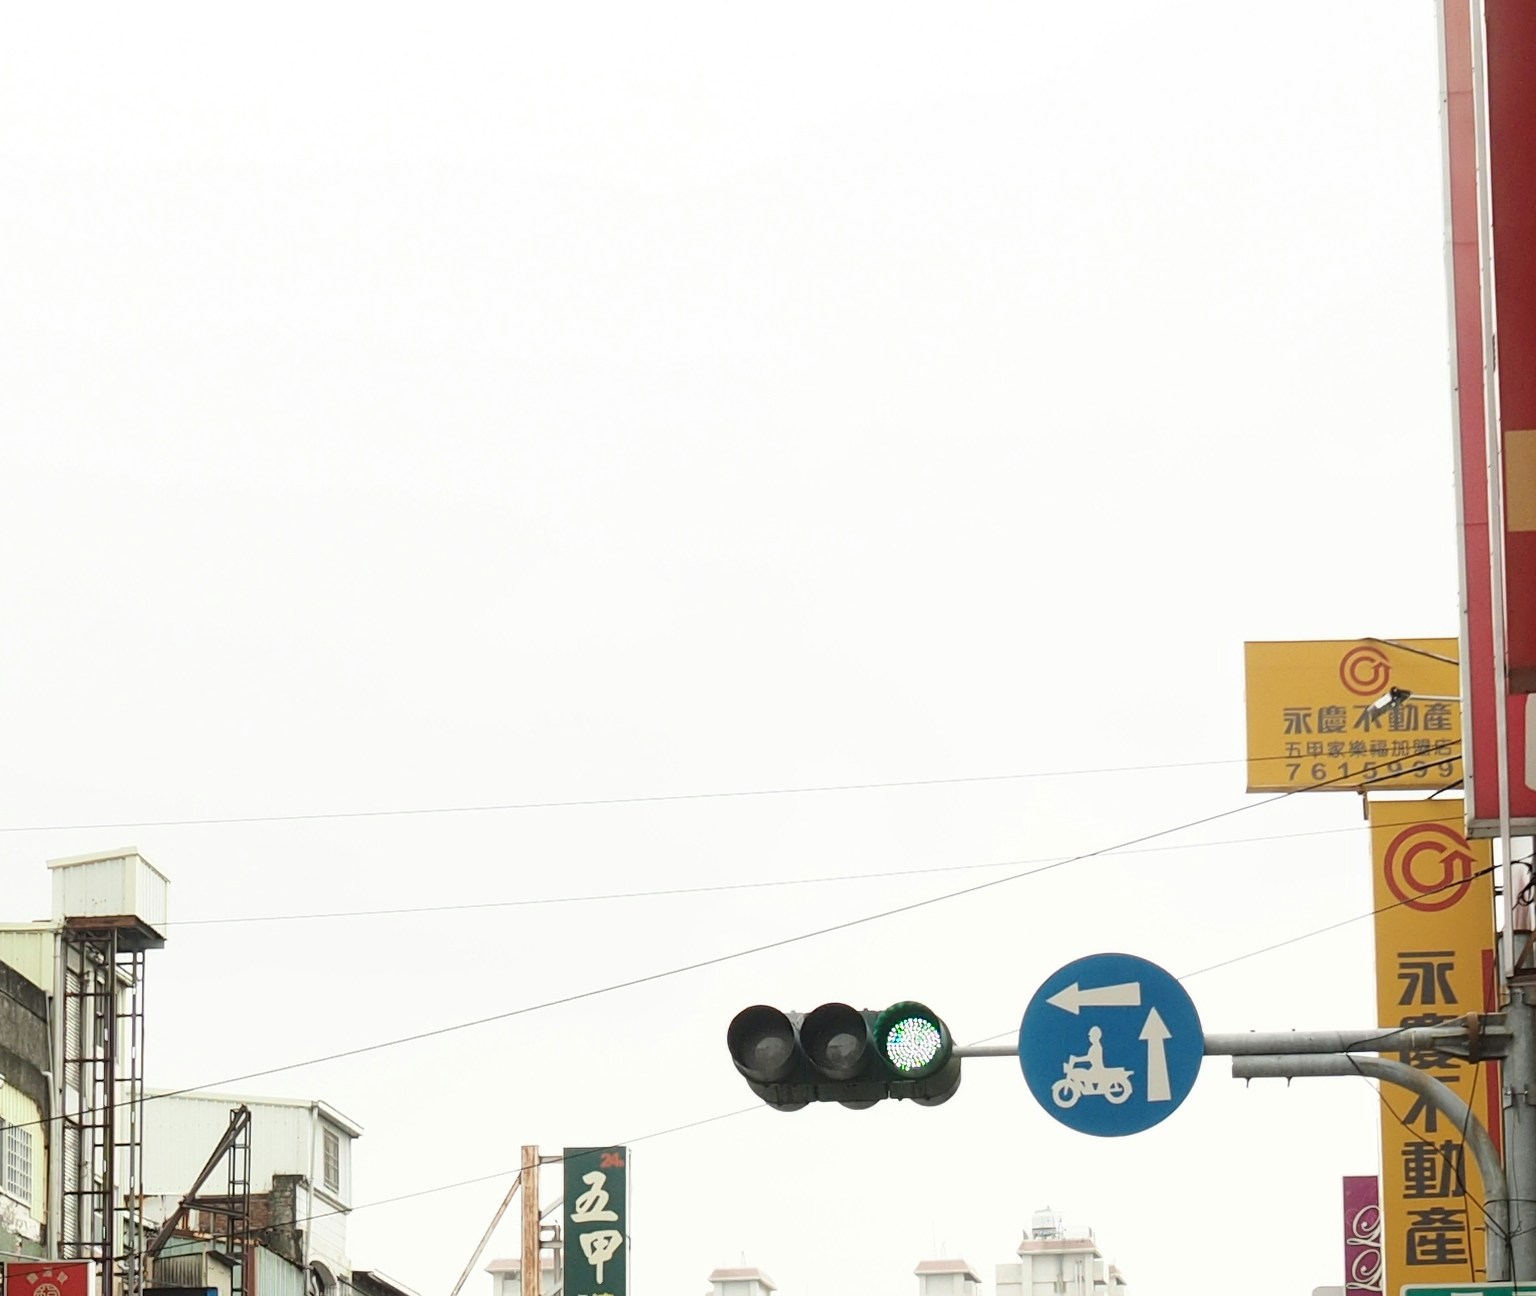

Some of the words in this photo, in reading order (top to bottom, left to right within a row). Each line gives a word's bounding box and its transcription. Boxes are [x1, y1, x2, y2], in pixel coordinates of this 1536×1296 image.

[1281, 703, 1454, 735] 永慶不動產
[569, 1170, 623, 1285] 五甲
